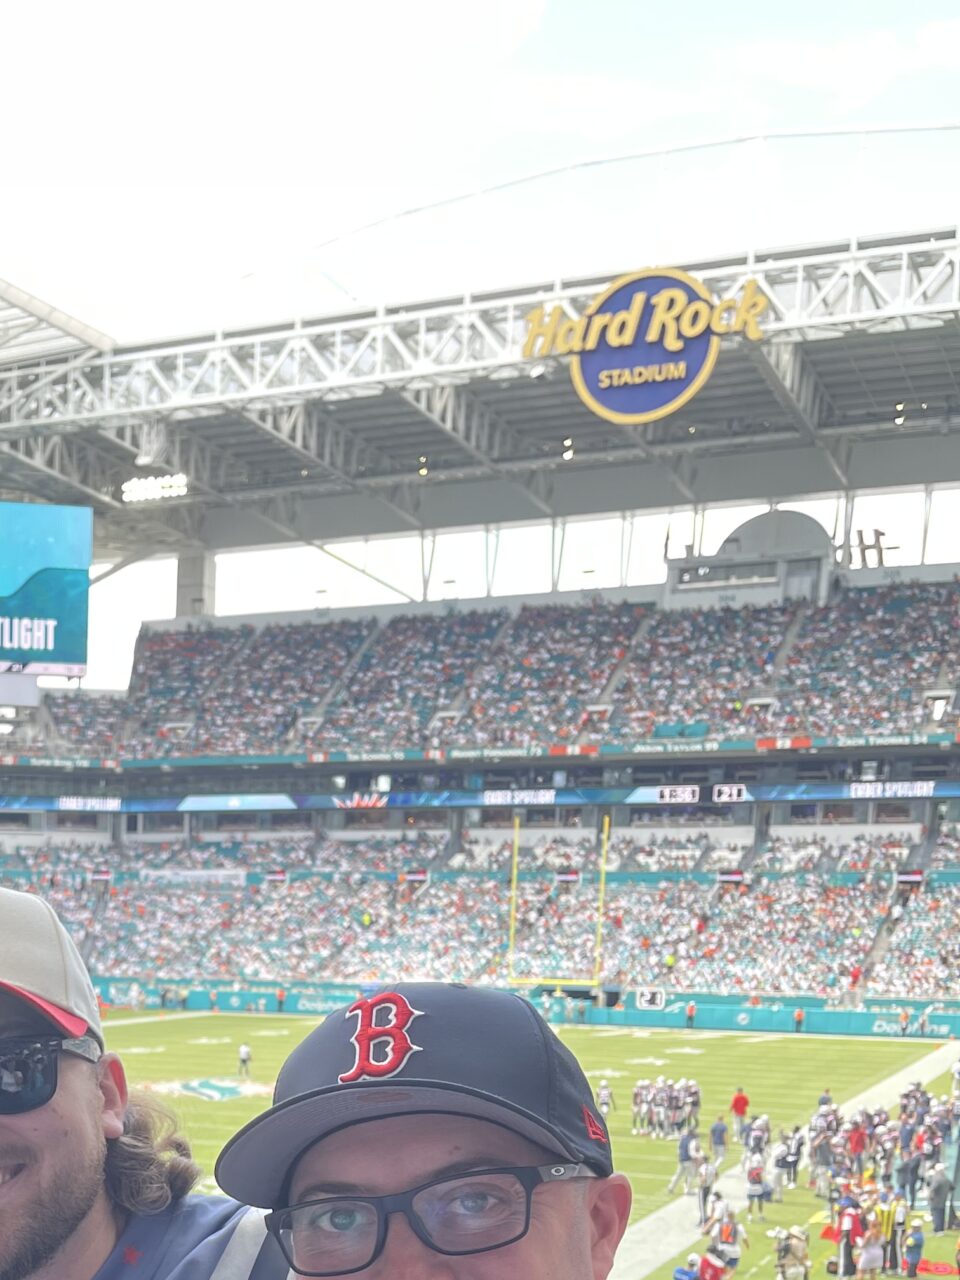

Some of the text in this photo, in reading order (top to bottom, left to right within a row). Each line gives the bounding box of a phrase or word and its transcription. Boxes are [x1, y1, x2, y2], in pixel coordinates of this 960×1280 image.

[522, 279, 769, 358] Hard Rock
[598, 361, 687, 389] STADIUM
[338, 991, 425, 1084] B
